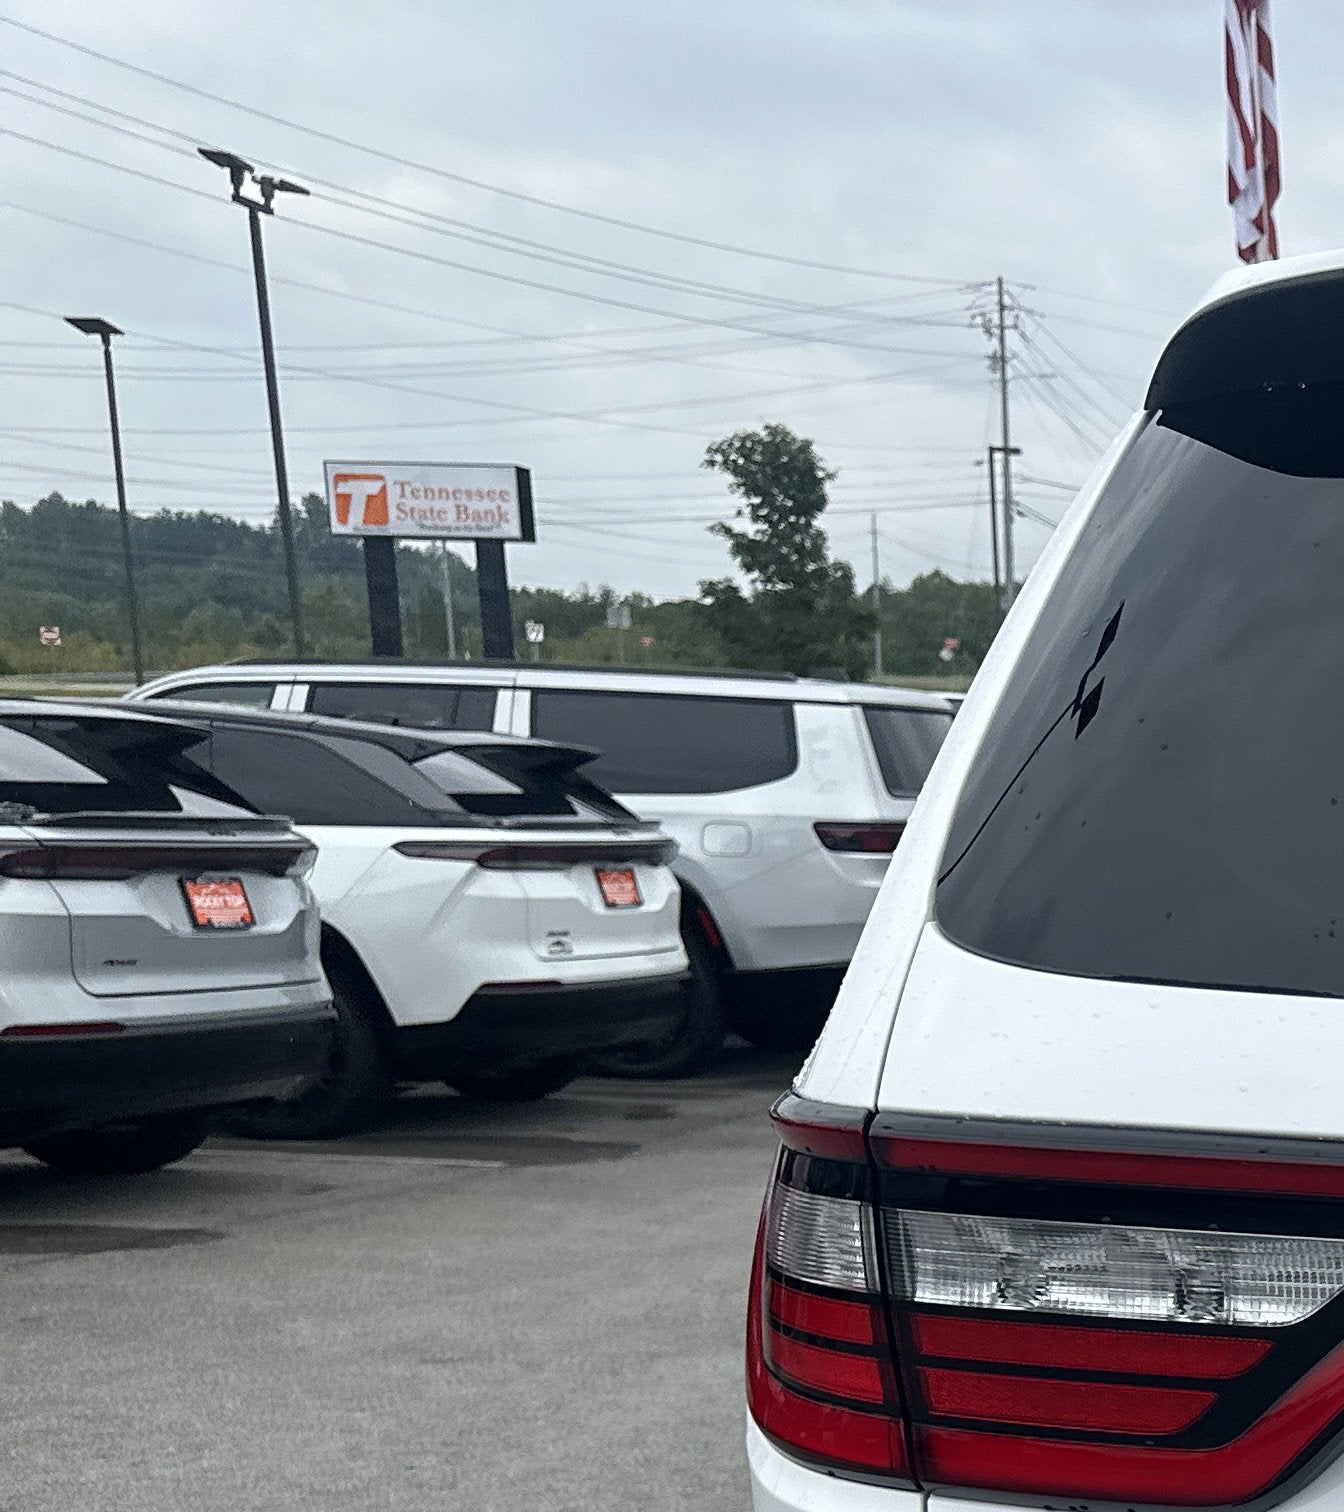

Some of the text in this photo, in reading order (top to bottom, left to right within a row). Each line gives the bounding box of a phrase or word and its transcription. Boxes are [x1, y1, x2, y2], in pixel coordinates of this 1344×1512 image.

[393, 480, 511, 502] Tennessee
[395, 502, 510, 523] State Bank
